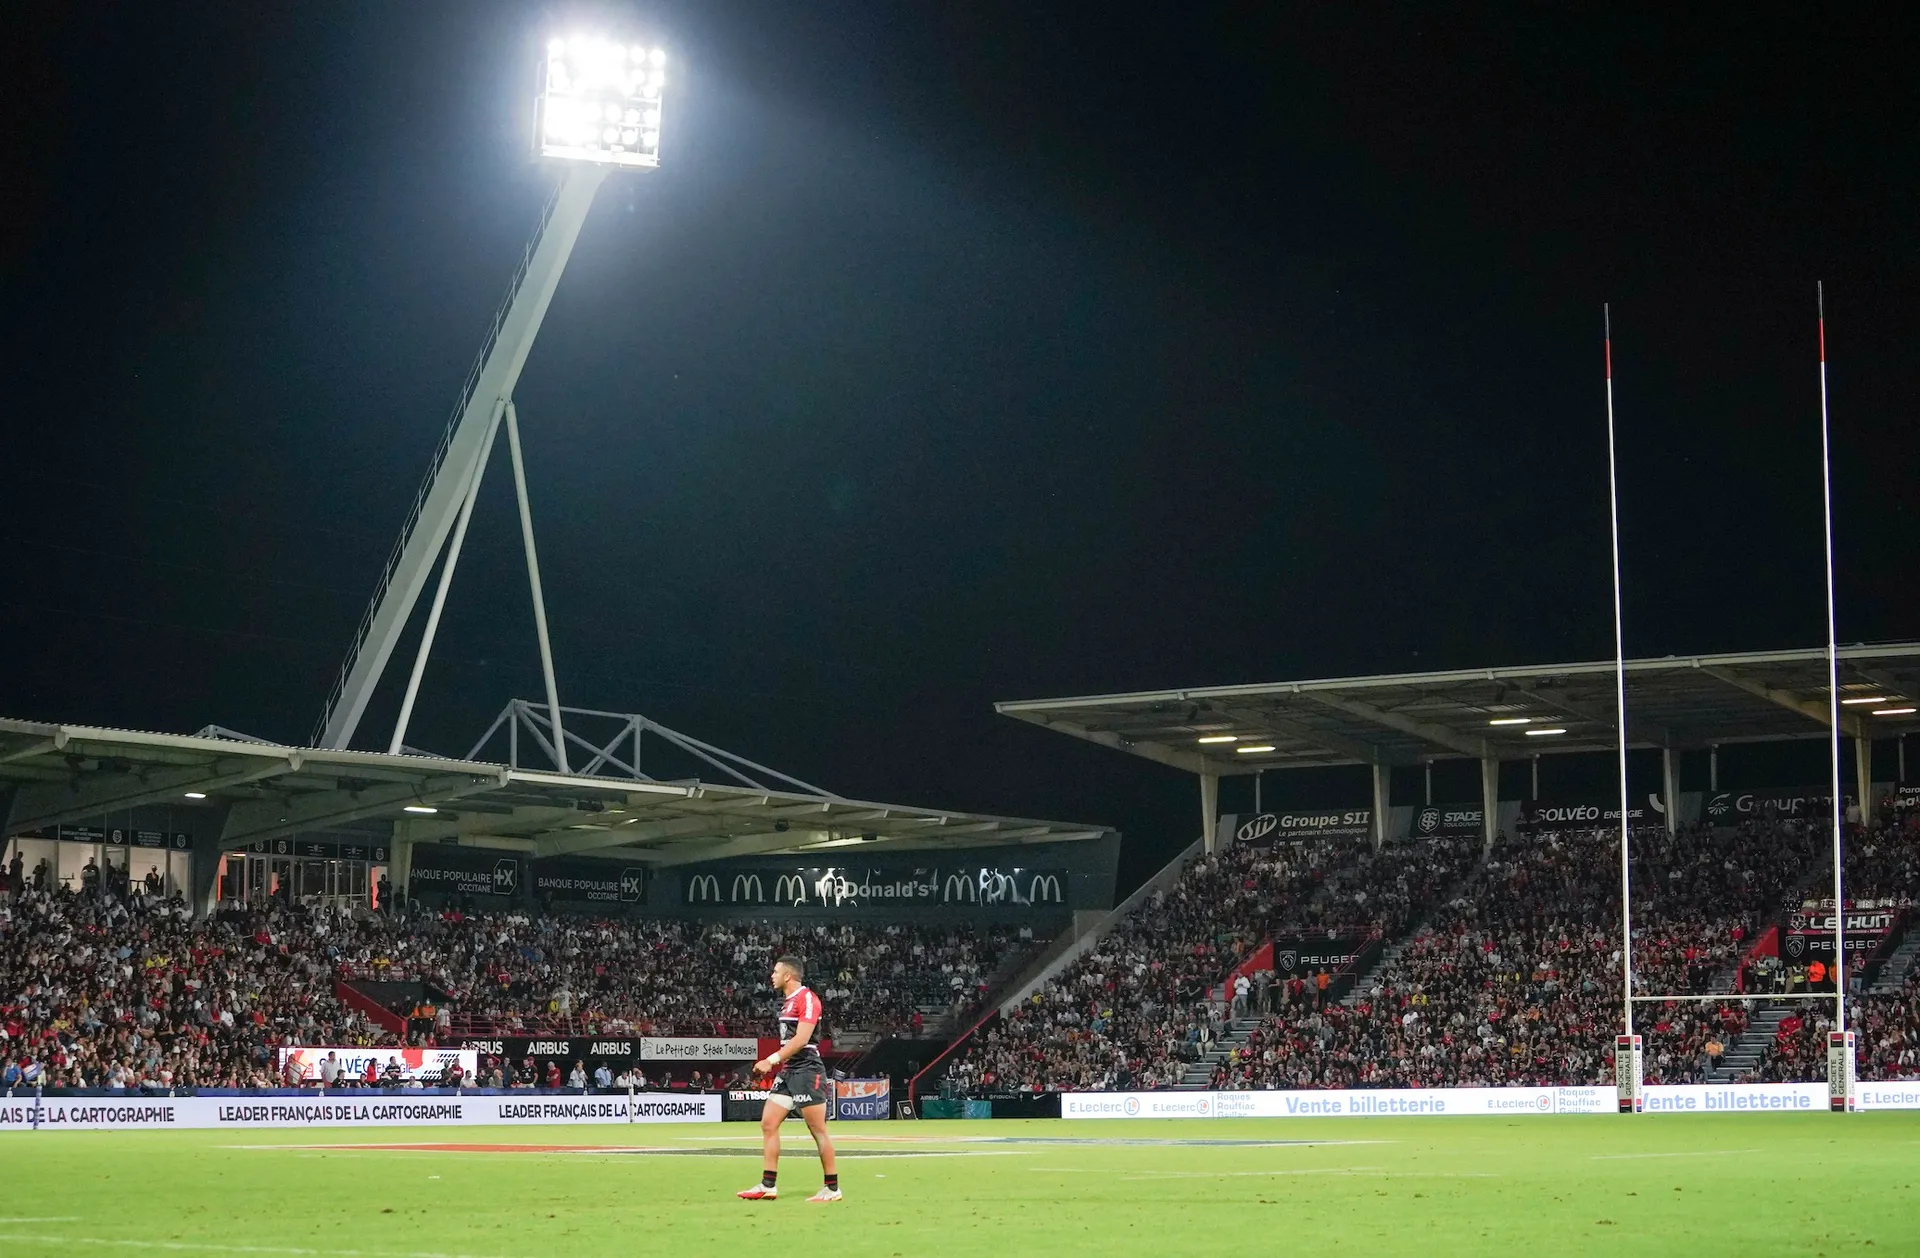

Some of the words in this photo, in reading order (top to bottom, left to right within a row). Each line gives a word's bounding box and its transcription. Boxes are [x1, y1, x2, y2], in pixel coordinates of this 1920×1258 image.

[1281, 814, 1339, 829] Groupe
[1343, 811, 1370, 825] SII
[1444, 811, 1482, 822] STADE
[1603, 809, 1643, 820] ENEGIE
[410, 868, 441, 880] ANQUE
[443, 870, 491, 883] POPULAIRE
[457, 883, 491, 893] OCCITANE
[538, 877, 573, 889] BANQUE
[574, 879, 619, 892] POPULAIRE
[587, 892, 619, 901] OCCITANE
[1847, 914, 1894, 929] HUIT
[527, 1041, 570, 1055] AIRBUS
[590, 1041, 631, 1055] AIRBUS
[665, 1043, 683, 1058] Petit
[703, 1043, 723, 1058] Stade
[724, 1043, 756, 1055] Toulousain
[1217, 1092, 1251, 1101] Roques
[1558, 1088, 1596, 1098] Roques
[1705, 1091, 1811, 1109] billetterie
[840, 1102, 875, 1116] GMF
[1069, 1102, 1122, 1113] E.Leclerc
[1153, 1103, 1196, 1112] E.Leclerc
[1285, 1096, 1342, 1114] Vente
[1350, 1096, 1446, 1113] billetterie
[1488, 1099, 1535, 1109] E.Leclerc
[1559, 1098, 1601, 1106] Rouffiac
[48, 1107, 67, 1123] LA
[70, 1106, 174, 1123] CARTOGRAPHIE
[219, 1106, 269, 1121] LEADER
[272, 1105, 333, 1123] FRANÇAIS
[336, 1105, 351, 1120] DE
[354, 1105, 370, 1120] LA
[373, 1104, 462, 1120] CARTOGRAPHIE
[499, 1104, 542, 1119] LEADER
[544, 1103, 597, 1120] FRANÇAIS
[599, 1103, 612, 1118] DE
[614, 1103, 628, 1117] LA
[632, 1102, 705, 1117] ARTOGRAPHIE
